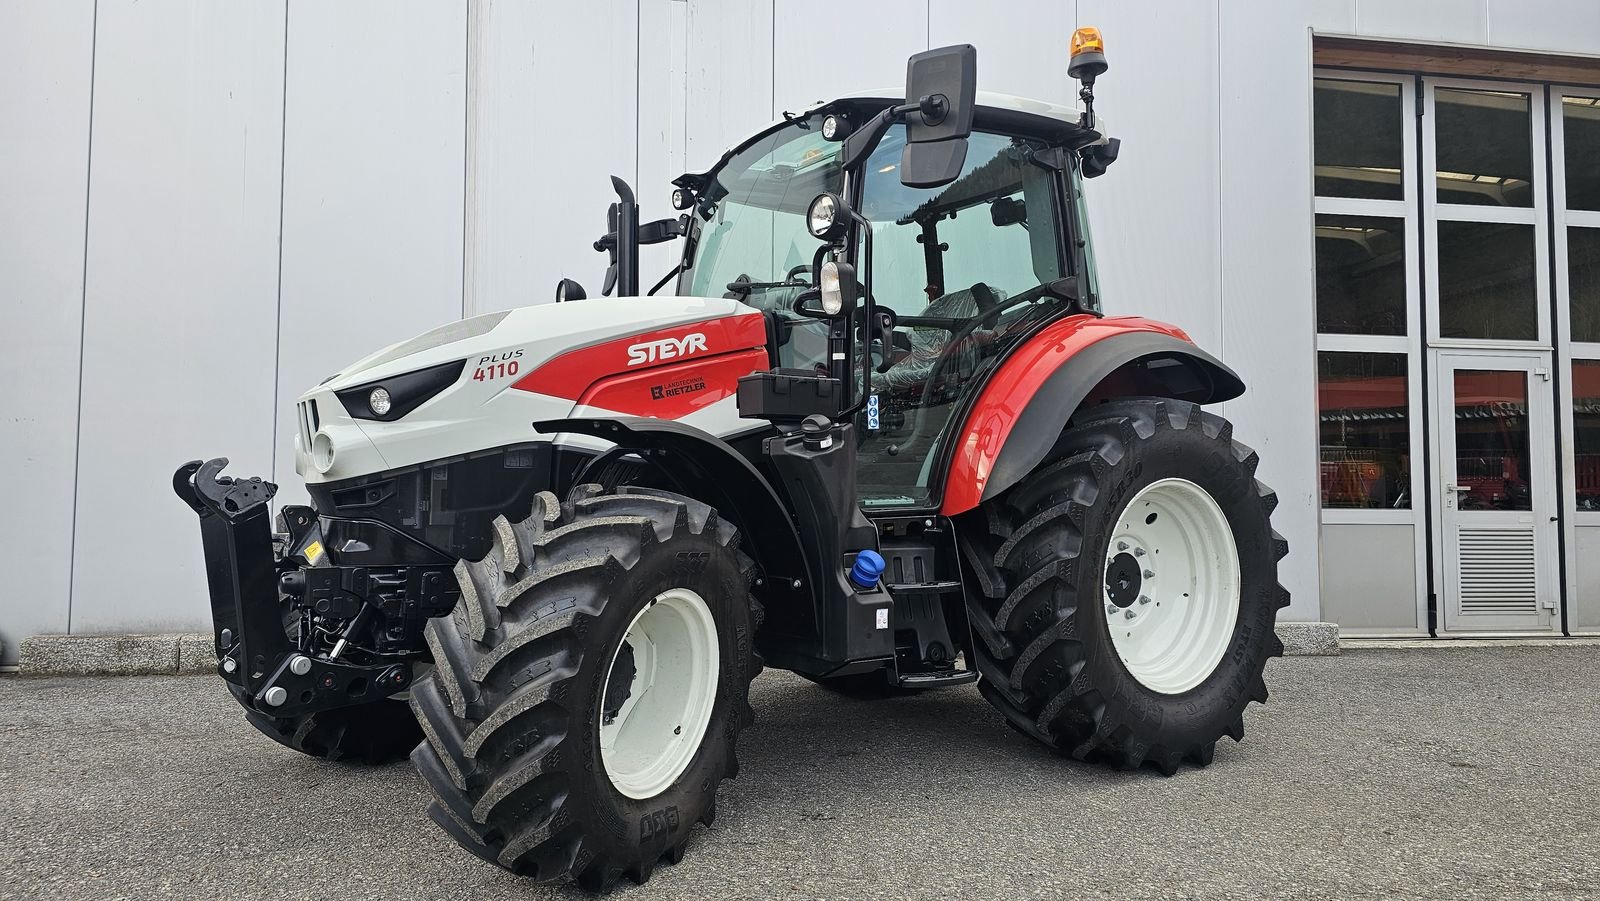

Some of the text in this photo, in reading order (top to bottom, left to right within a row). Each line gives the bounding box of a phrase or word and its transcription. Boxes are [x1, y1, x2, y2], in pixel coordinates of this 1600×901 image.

[479, 349, 524, 365] PLUS
[627, 333, 709, 366] STEYR
[473, 361, 518, 381] 4110
[663, 376, 704, 389] LANDTECHNIK
[665, 382, 706, 397] RIETZLER
